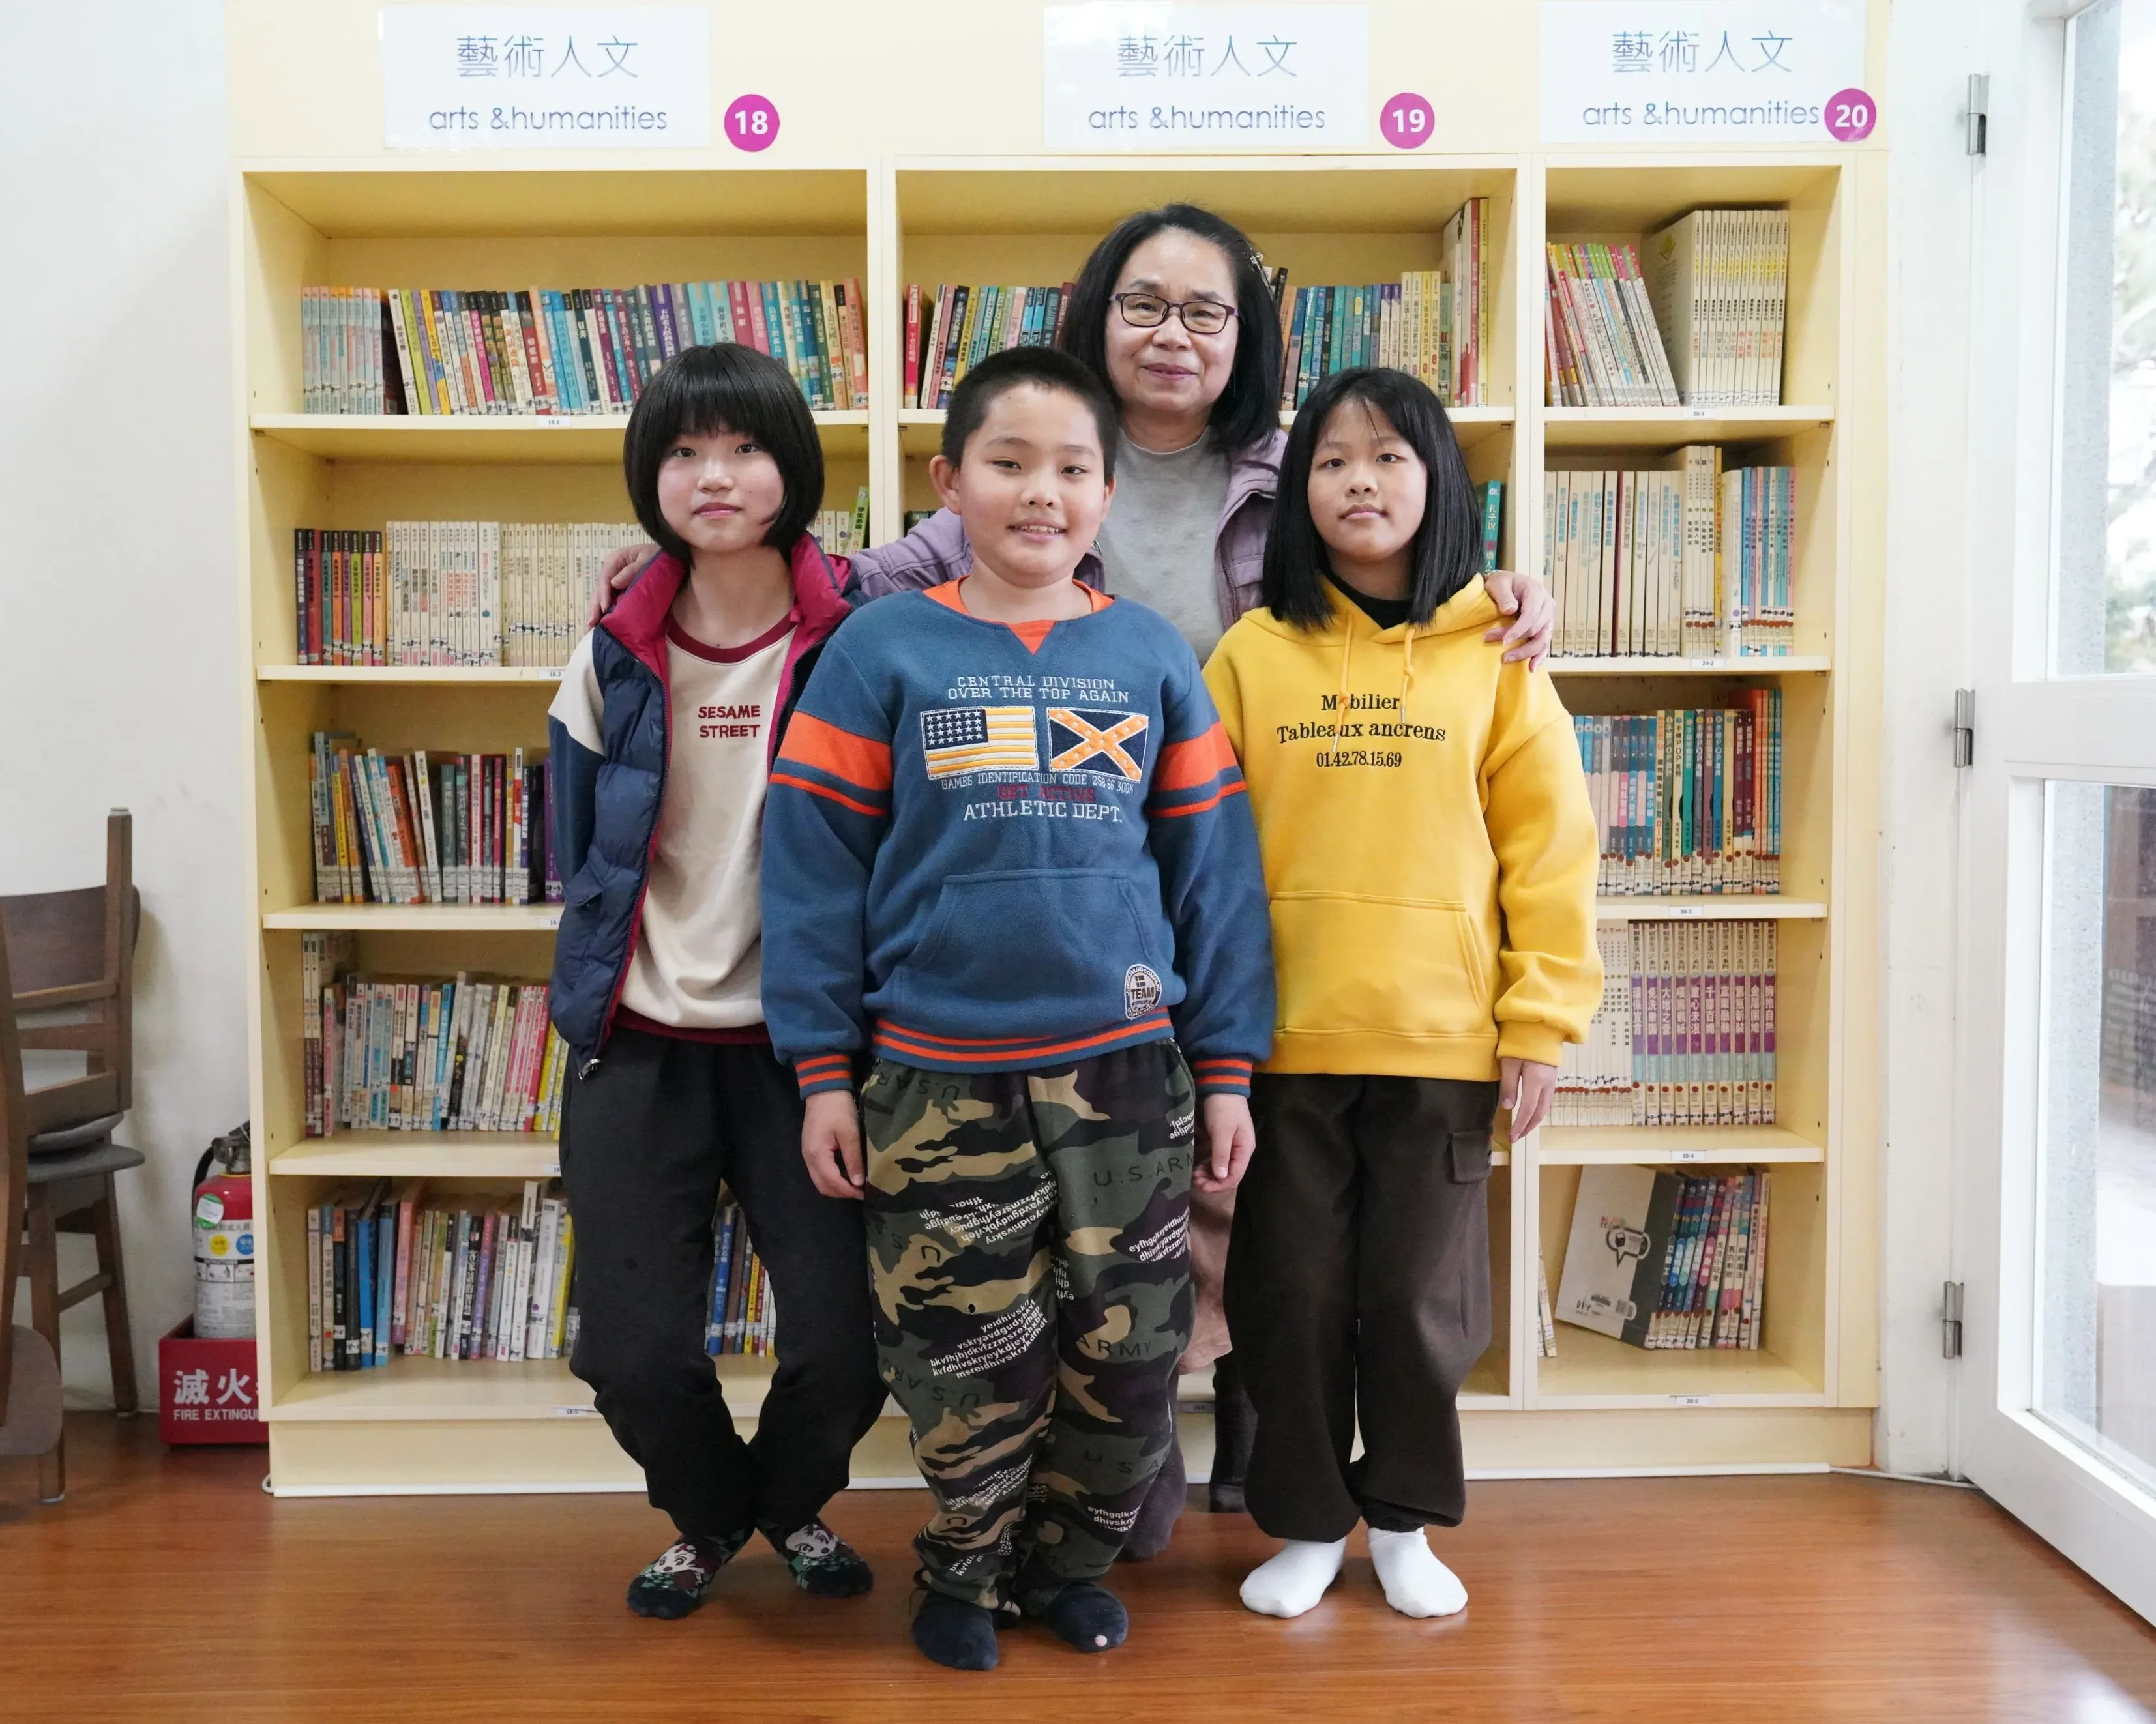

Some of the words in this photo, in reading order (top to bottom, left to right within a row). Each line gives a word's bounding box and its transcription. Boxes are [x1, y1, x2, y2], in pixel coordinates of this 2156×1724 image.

[457, 35, 638, 78] 藝術人文
[1117, 35, 1297, 77] 藝術人文
[1612, 30, 1793, 73] 藝術人文
[429, 106, 479, 130] arts
[491, 106, 667, 130] &humanities
[735, 110, 768, 135] 18
[1088, 106, 1138, 129] arts
[1149, 105, 1325, 129] &humanities
[1393, 108, 1425, 133] 19
[1582, 101, 1632, 126] arts
[1643, 100, 1819, 126] &humanities
[1835, 105, 1868, 128] 20
[958, 675, 1035, 688] CENTRAL
[1042, 676, 1114, 690] DIVISION
[948, 687, 992, 699] OVER
[1000, 687, 1033, 699] THE
[1039, 688, 1071, 699] TOP
[1079, 690, 1129, 703] AGAIN
[1321, 694, 1400, 710] Mbilier
[698, 705, 760, 719] SESAME
[700, 724, 760, 738] STREET
[1277, 722, 1363, 743] Tableaux
[1369, 722, 1446, 742] ancrens
[1316, 751, 1402, 767] 01.42.78.15.69
[941, 775, 973, 789] GAMES
[978, 772, 1056, 784] IDENTIFICATION
[1063, 773, 1087, 785] CODE
[1038, 785, 1095, 801] ACTIVE
[964, 800, 1067, 821] ATHLETIC
[1073, 803, 1123, 823] DEPT.
[1130, 987, 1155, 999] TEAM
[173, 1369, 258, 1405] 滅火
[173, 1409, 199, 1420] FIRE
